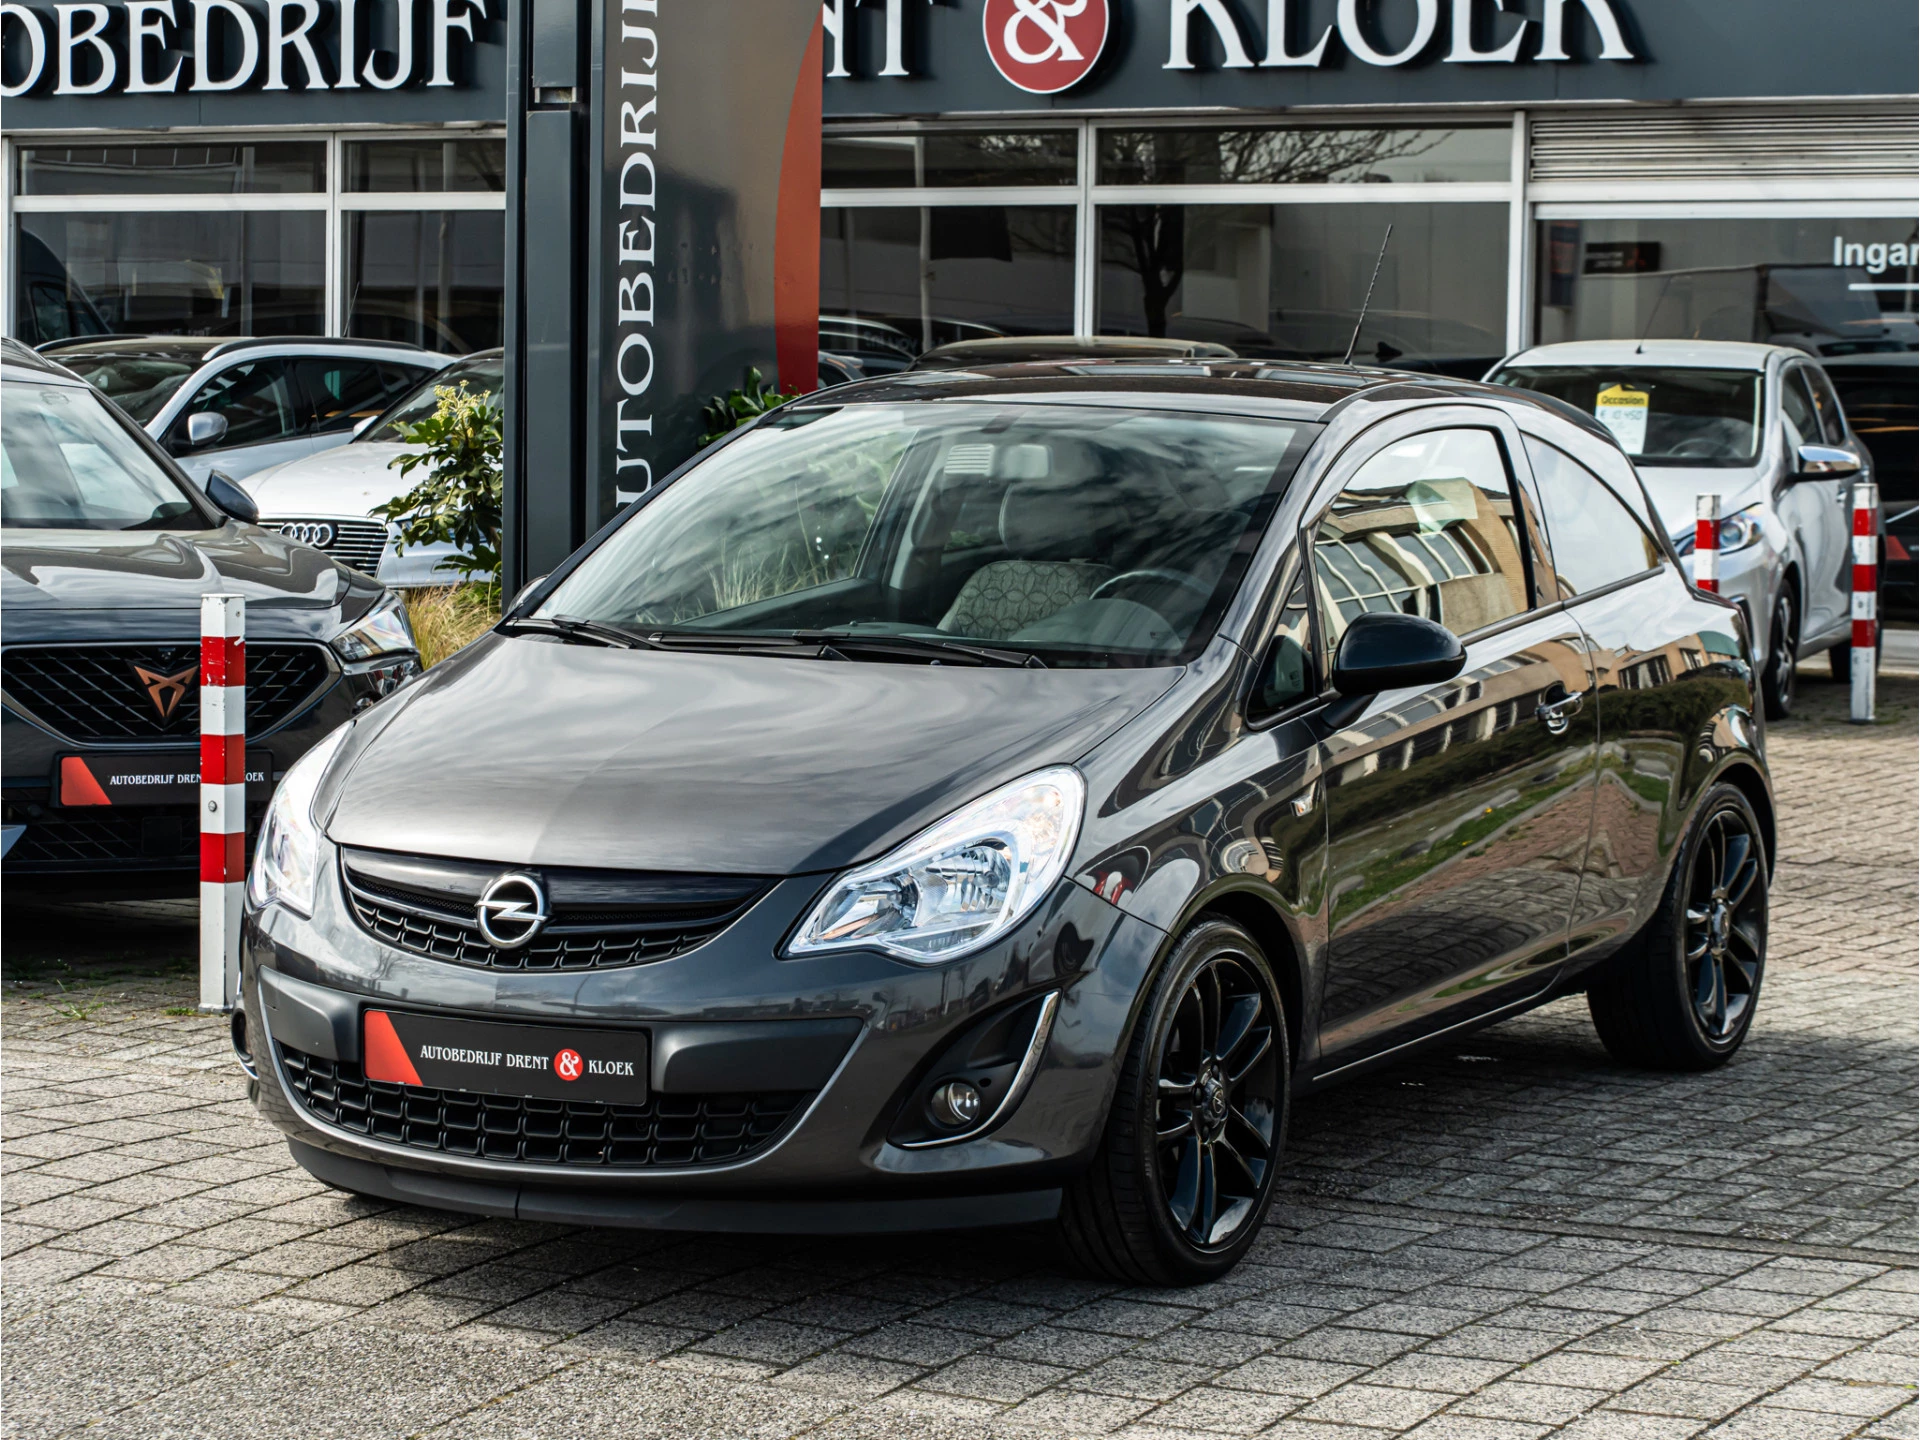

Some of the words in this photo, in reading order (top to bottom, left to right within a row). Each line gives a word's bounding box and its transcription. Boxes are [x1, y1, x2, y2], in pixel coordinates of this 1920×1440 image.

[109, 774, 174, 785] AUTOBEDRIJF
[420, 1045, 502, 1066] AUTOBEDRIJF
[506, 1053, 549, 1070] DRENT
[560, 1052, 579, 1077] &
[588, 1059, 634, 1076] KLOEK
